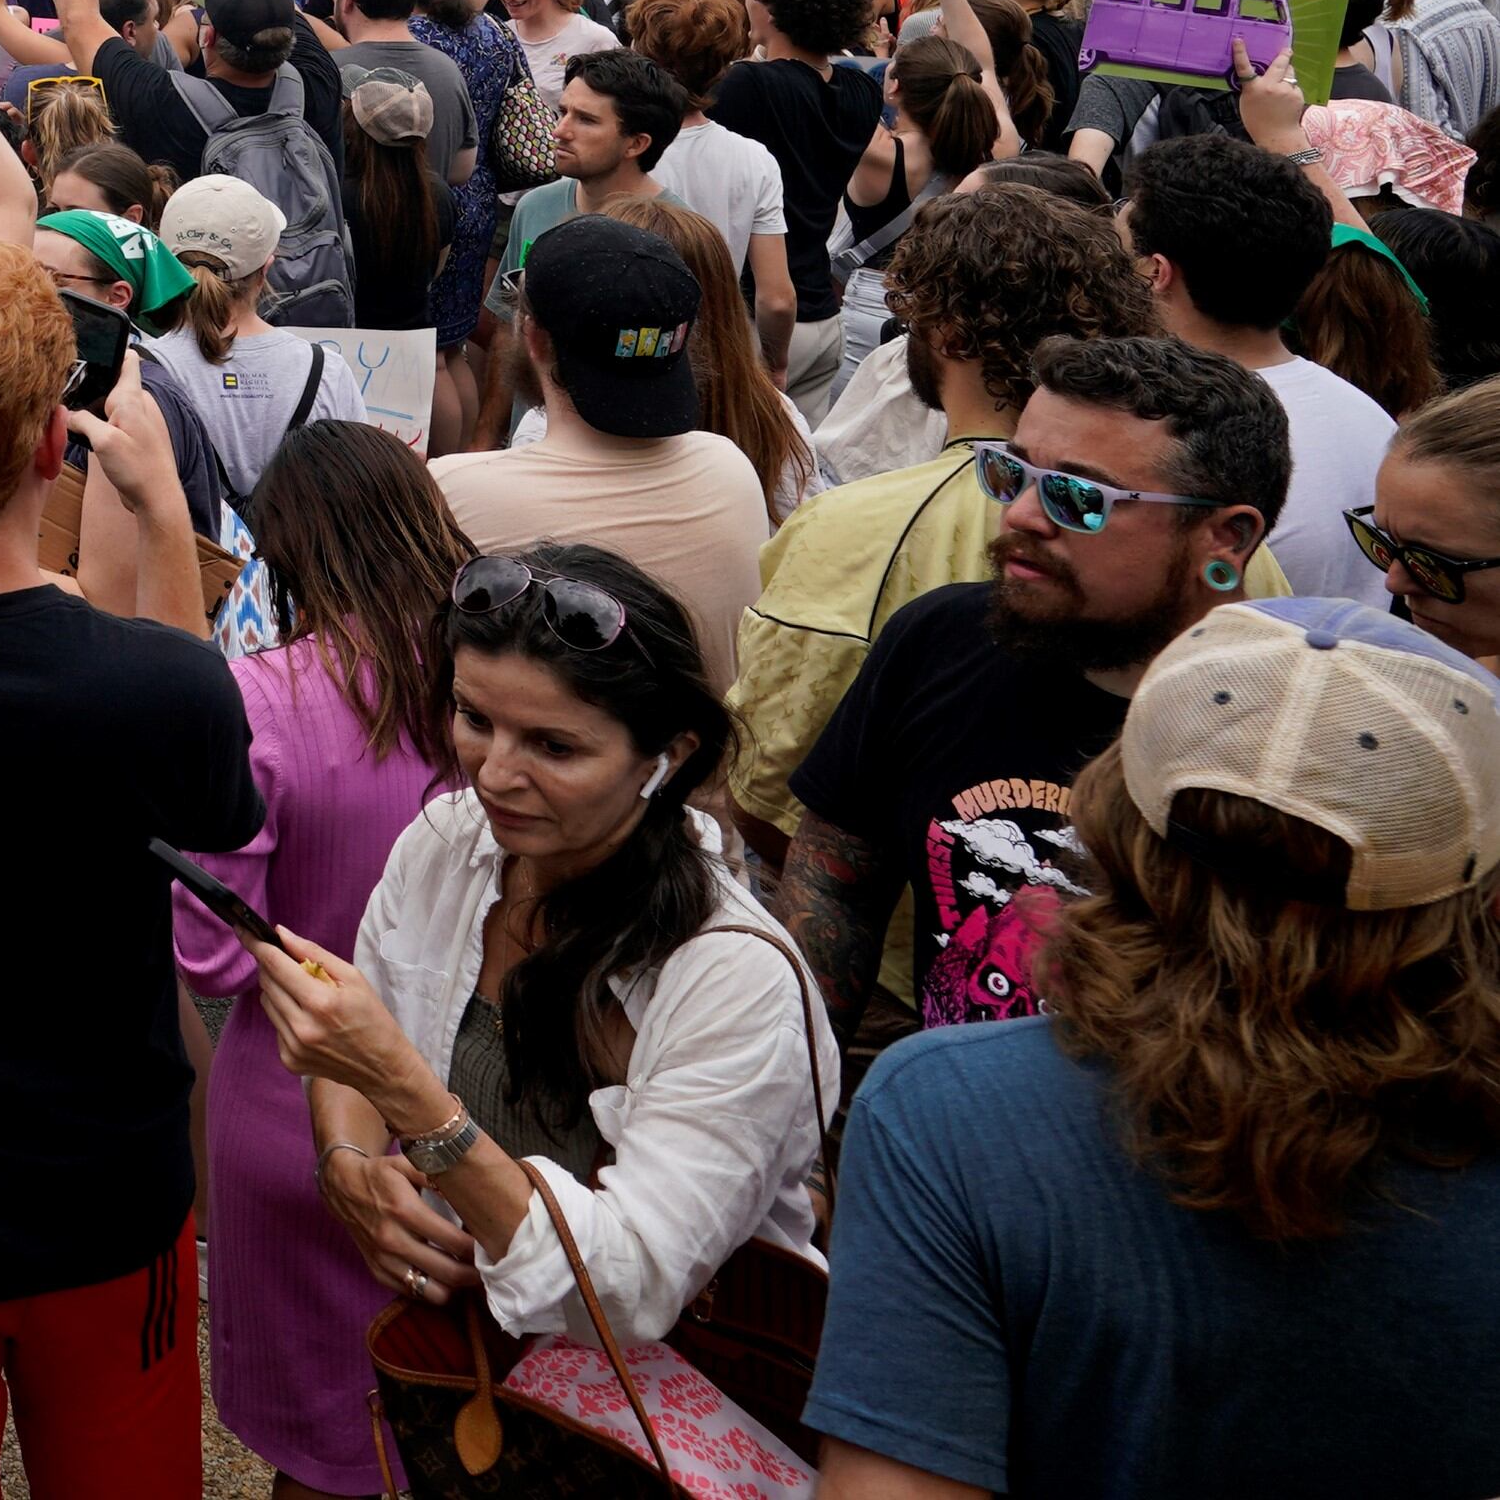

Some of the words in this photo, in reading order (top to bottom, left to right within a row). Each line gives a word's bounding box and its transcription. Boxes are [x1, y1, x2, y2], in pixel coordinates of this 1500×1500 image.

[186, 229, 206, 241] Clay
[208, 232, 219, 242] &
[926, 817, 962, 930] THIRST
